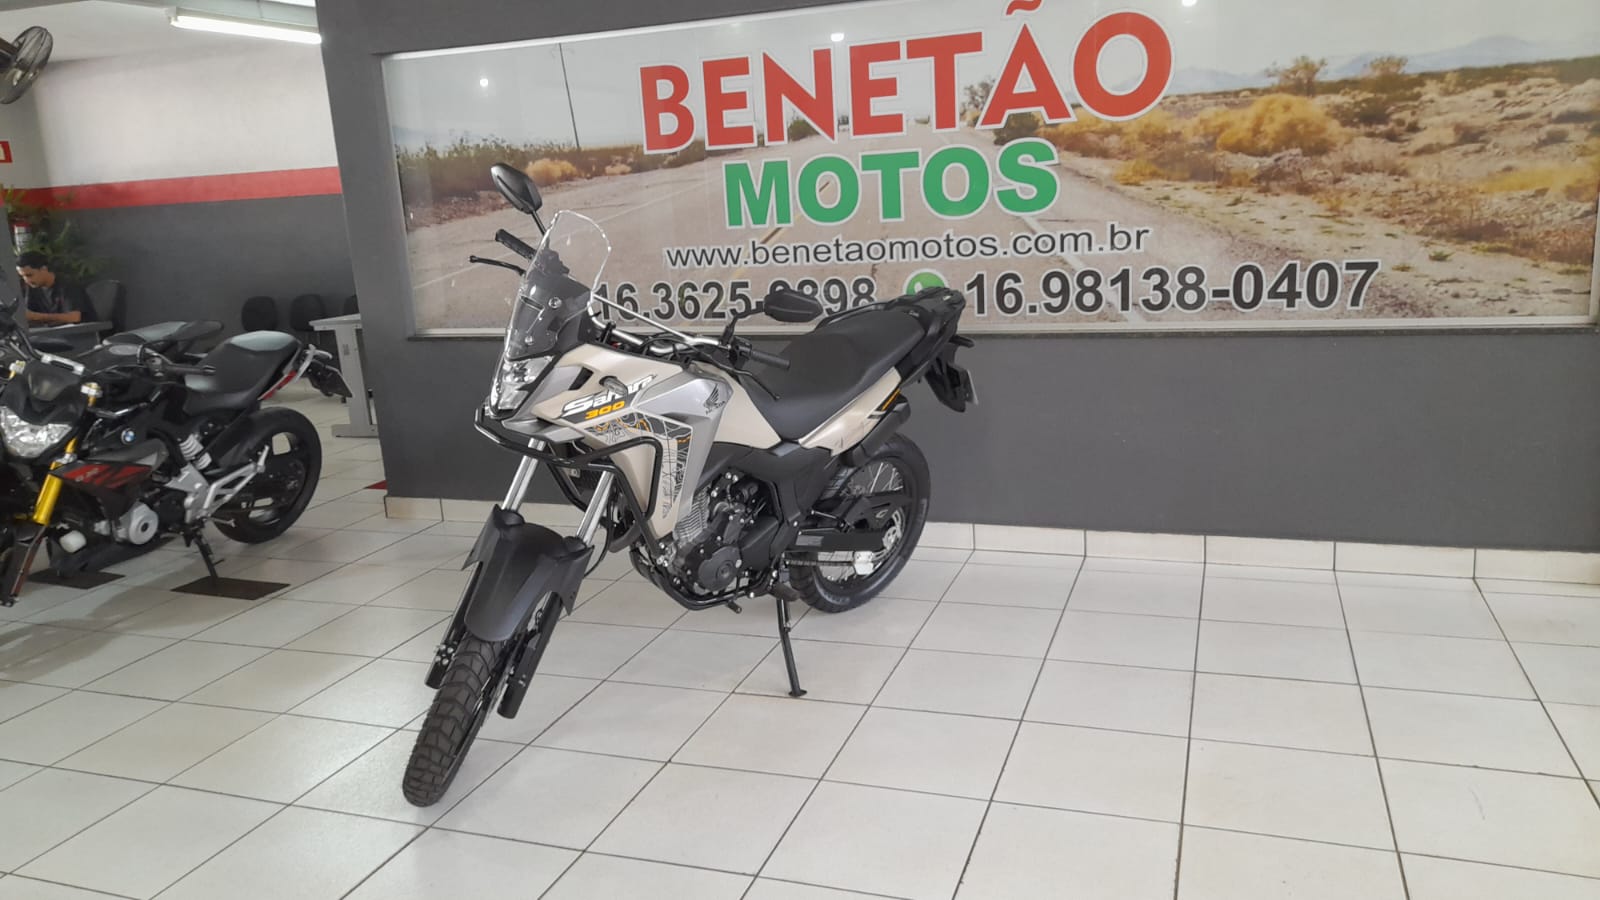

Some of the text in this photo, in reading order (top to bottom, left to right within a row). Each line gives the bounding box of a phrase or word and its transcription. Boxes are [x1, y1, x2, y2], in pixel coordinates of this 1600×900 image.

[640, 0, 1172, 151] BENETÃO
[725, 141, 1057, 227] MOTOS
[665, 223, 1151, 267] www.benetaomotos.com.br
[966, 262, 1379, 315] 16.98138-0407
[584, 400, 625, 420] 300
